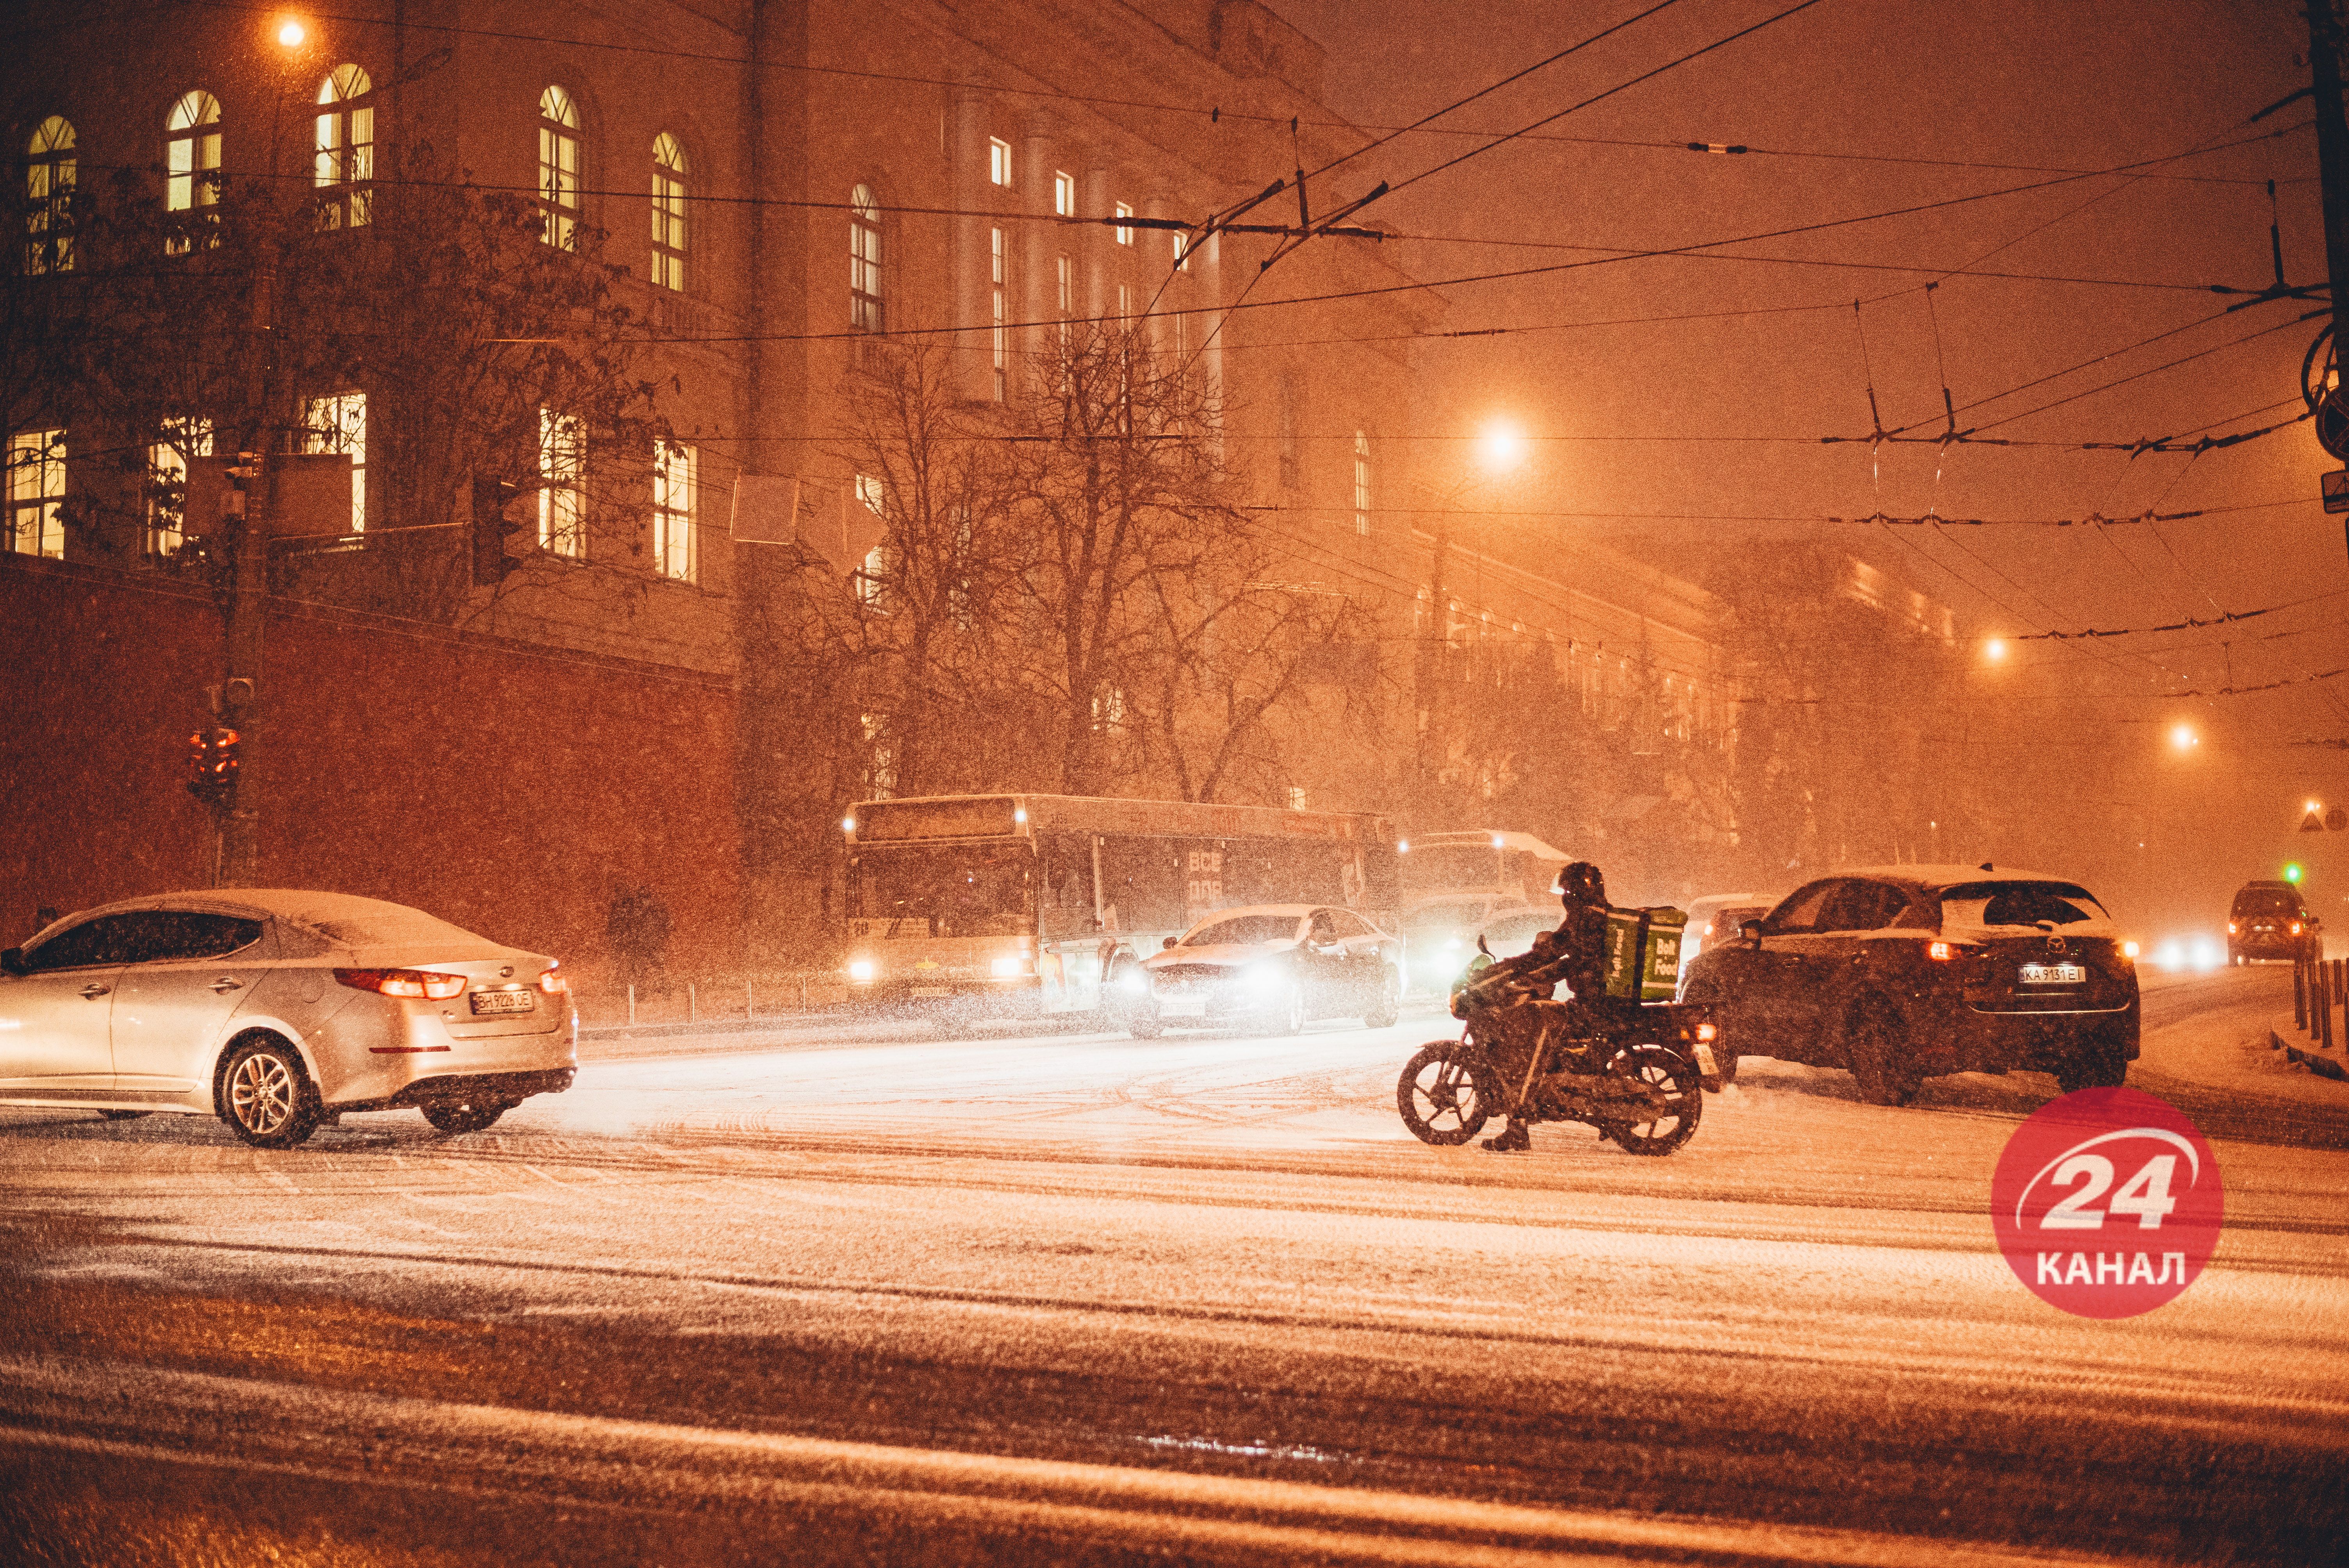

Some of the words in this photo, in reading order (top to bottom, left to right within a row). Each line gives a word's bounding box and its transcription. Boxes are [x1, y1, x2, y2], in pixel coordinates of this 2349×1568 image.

[1613, 928, 1624, 955] Food
[1656, 938, 1675, 955] Bolt
[1654, 959, 1678, 975] Food
[2025, 969, 2041, 980] KA
[2043, 969, 2066, 980] 9131
[2068, 969, 2080, 980] EI
[478, 995, 493, 1008] BH
